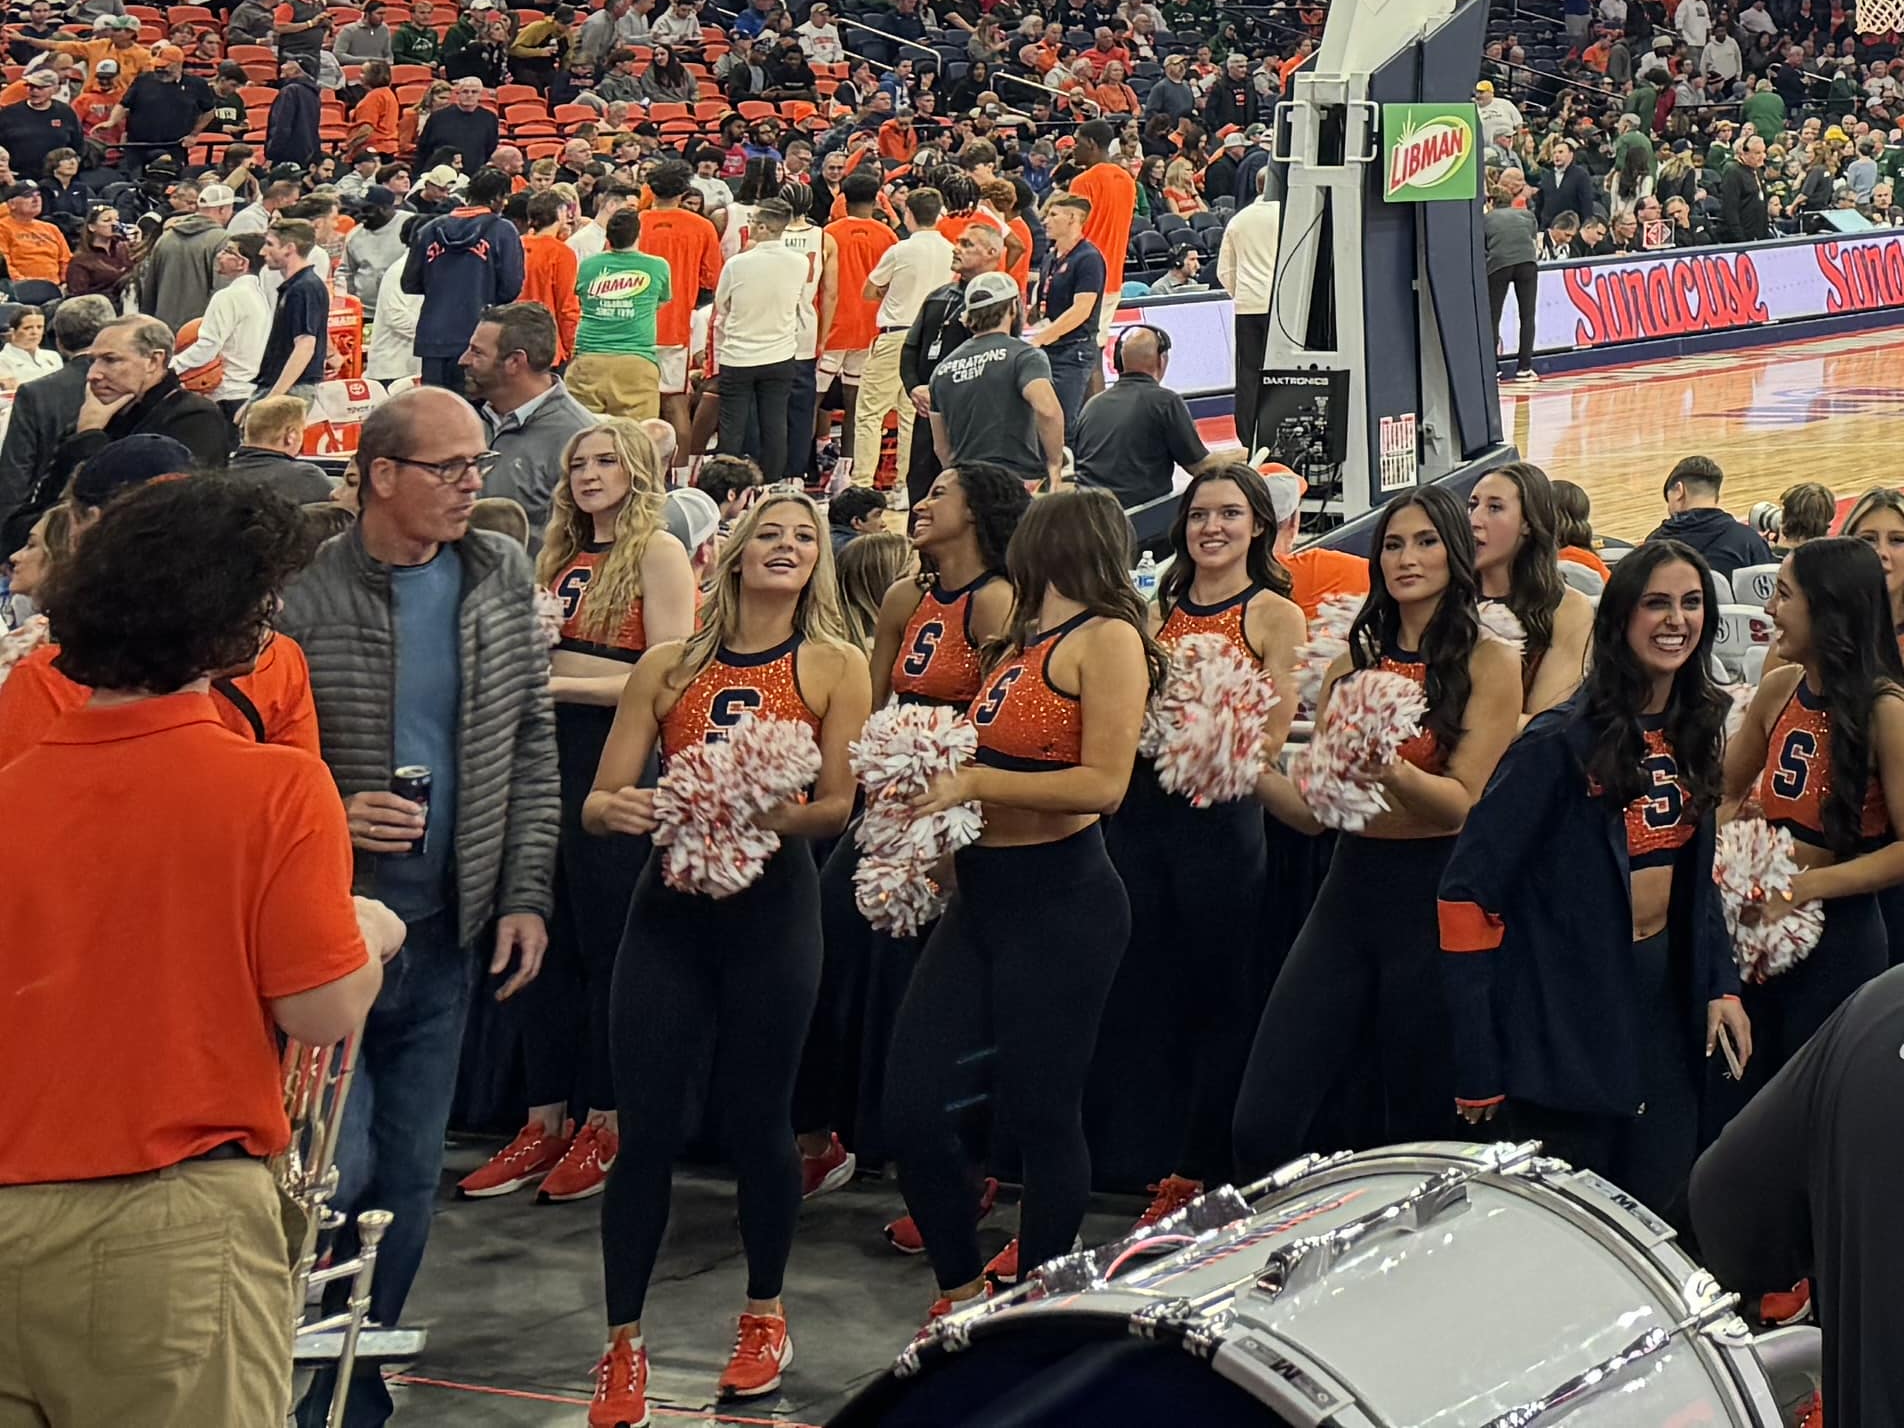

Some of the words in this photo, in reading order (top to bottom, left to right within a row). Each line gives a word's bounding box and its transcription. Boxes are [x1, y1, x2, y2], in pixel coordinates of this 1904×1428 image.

[1390, 126, 1464, 184] LIBMAN
[589, 275, 646, 298] LIBMAN
[1564, 251, 1768, 345] Syracuse
[938, 347, 1006, 376] OPERATIONS
[952, 364, 984, 384] CREW
[1263, 376, 1329, 386] DAKTRONICS
[902, 619, 943, 677] S
[1771, 728, 1818, 801] S
